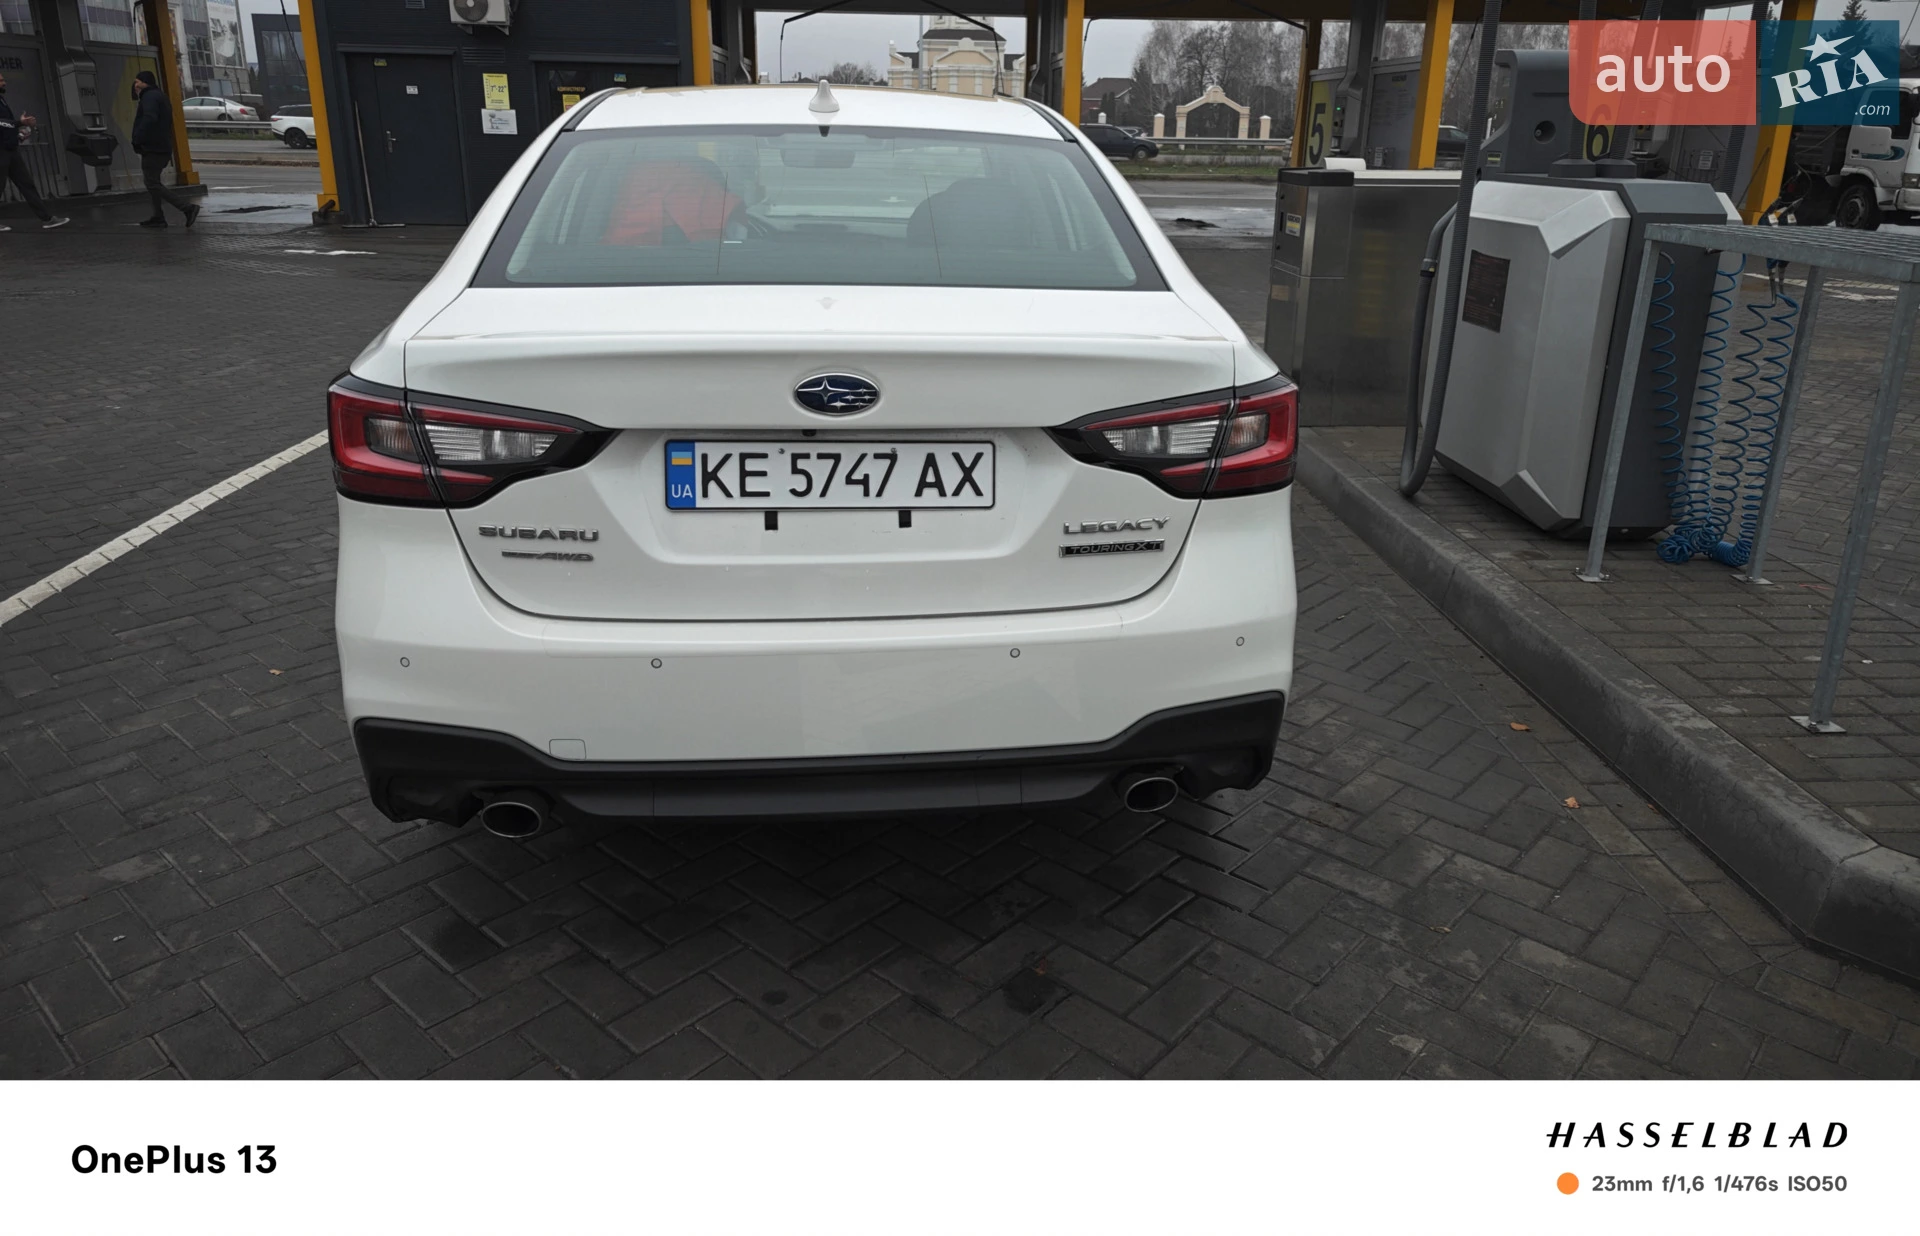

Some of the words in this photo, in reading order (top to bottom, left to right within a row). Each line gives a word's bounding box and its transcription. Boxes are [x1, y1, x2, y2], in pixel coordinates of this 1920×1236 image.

[1309, 103, 1326, 165] 5
[1587, 104, 1612, 163] 6
[701, 452, 771, 498] KE
[789, 452, 898, 498] 5747
[914, 451, 984, 497] AX
[671, 484, 693, 498] UA
[478, 525, 599, 542] SUBARU
[1063, 516, 1170, 535] LEGACY
[535, 552, 594, 562] AWD
[1070, 544, 1135, 554] TOURING
